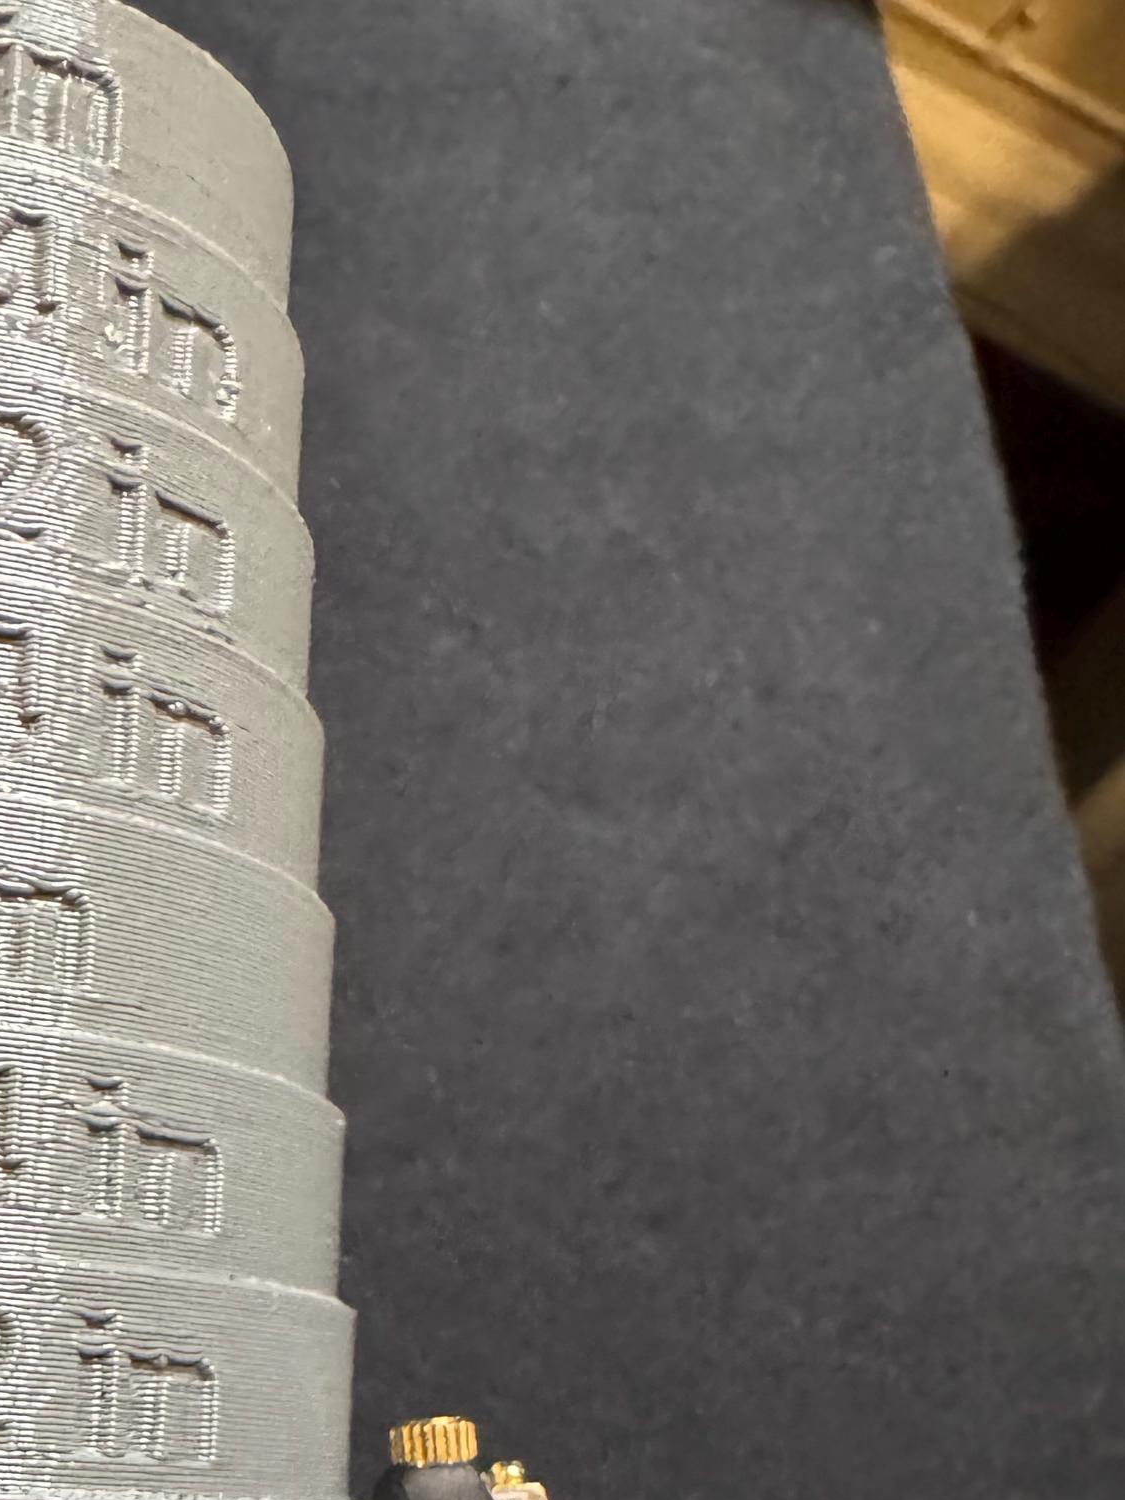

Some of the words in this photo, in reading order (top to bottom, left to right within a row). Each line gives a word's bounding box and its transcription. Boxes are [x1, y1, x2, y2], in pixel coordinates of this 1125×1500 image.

[111, 240, 239, 420] in
[105, 436, 239, 622] in
[99, 644, 233, 818] in
[83, 1075, 225, 1237] in
[75, 1306, 219, 1475] in
